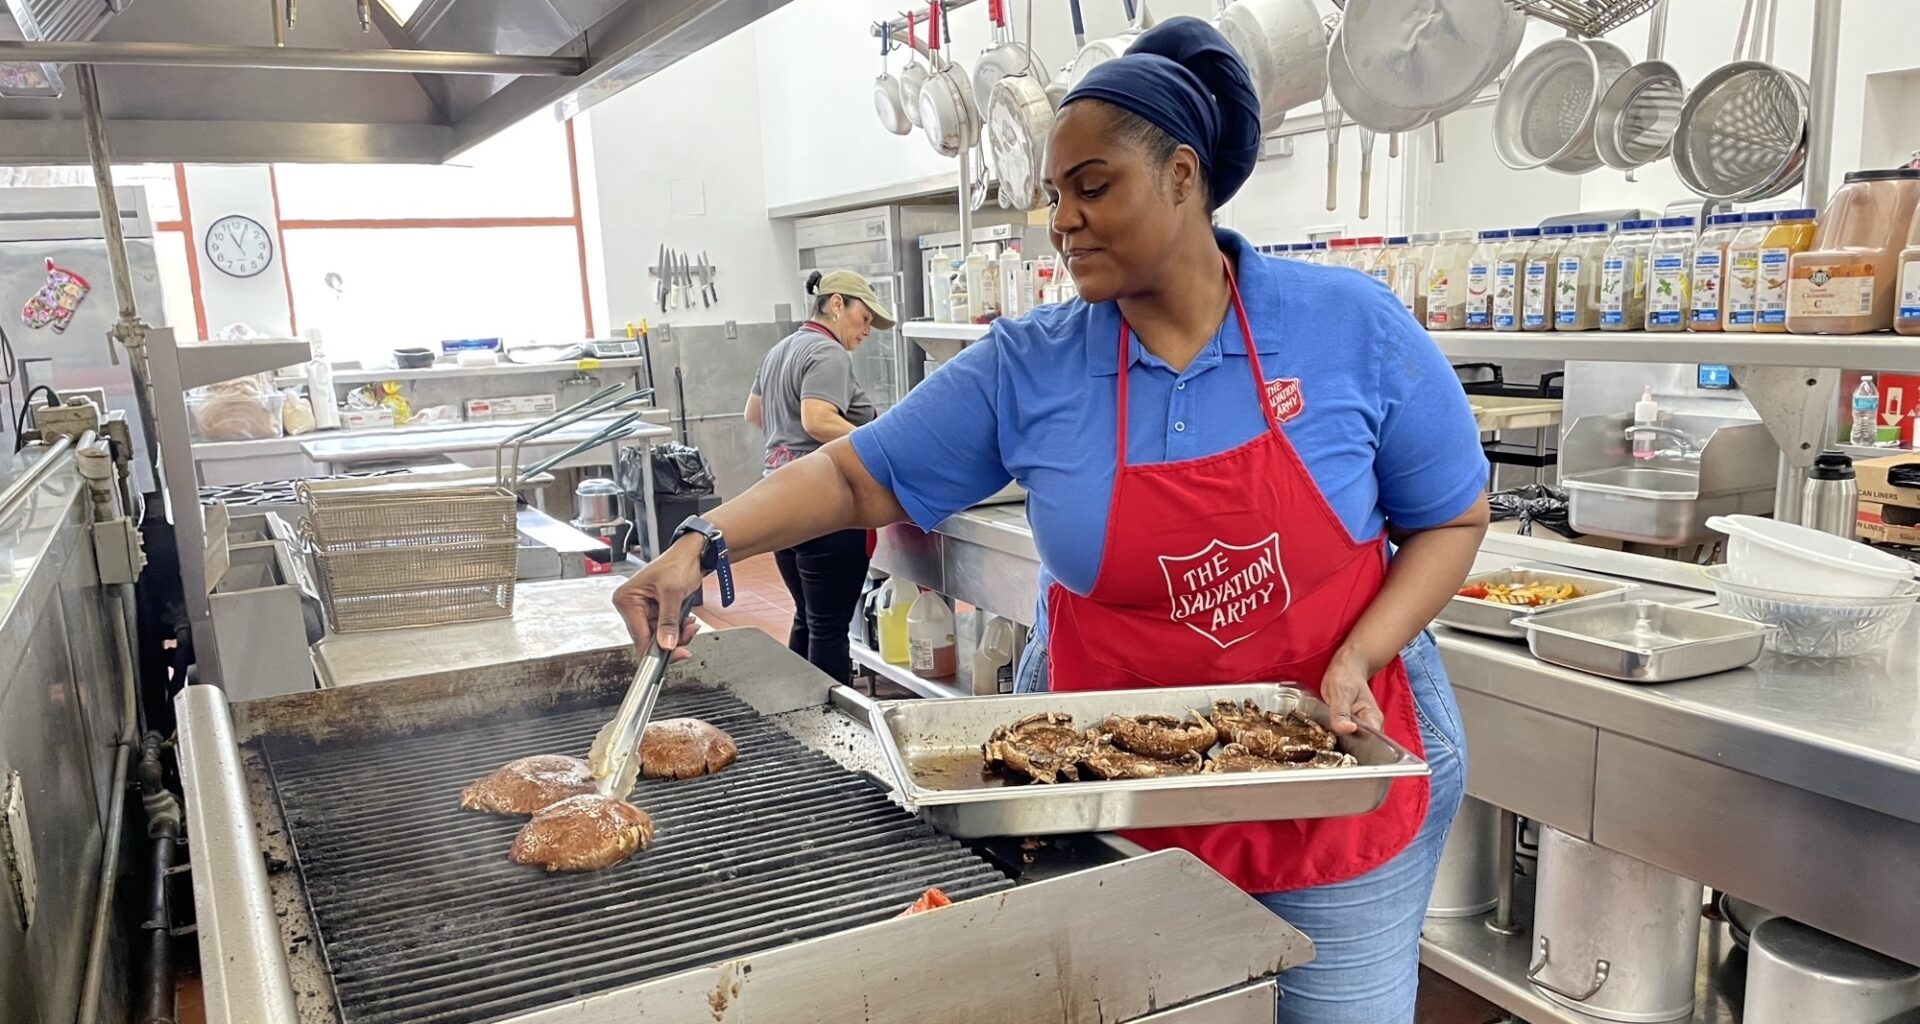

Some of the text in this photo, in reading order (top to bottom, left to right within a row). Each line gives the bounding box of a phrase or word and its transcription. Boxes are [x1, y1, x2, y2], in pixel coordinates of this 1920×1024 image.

[214, 232, 224, 241] 10
[253, 230, 261, 240] 2
[211, 243, 220, 252] 9
[259, 241, 266, 250] 3
[217, 253, 225, 262] 8
[257, 252, 265, 260] 4
[227, 260, 233, 269] 7
[1265, 381, 1282, 398] THE
[1269, 380, 1297, 408] ALVATION
[1277, 393, 1298, 417] ARMY
[1858, 489, 1898, 500] CAN LINERS
[1183, 551, 1229, 591] THE
[1175, 547, 1276, 618] SALVATION
[1211, 582, 1274, 632] ARMY
